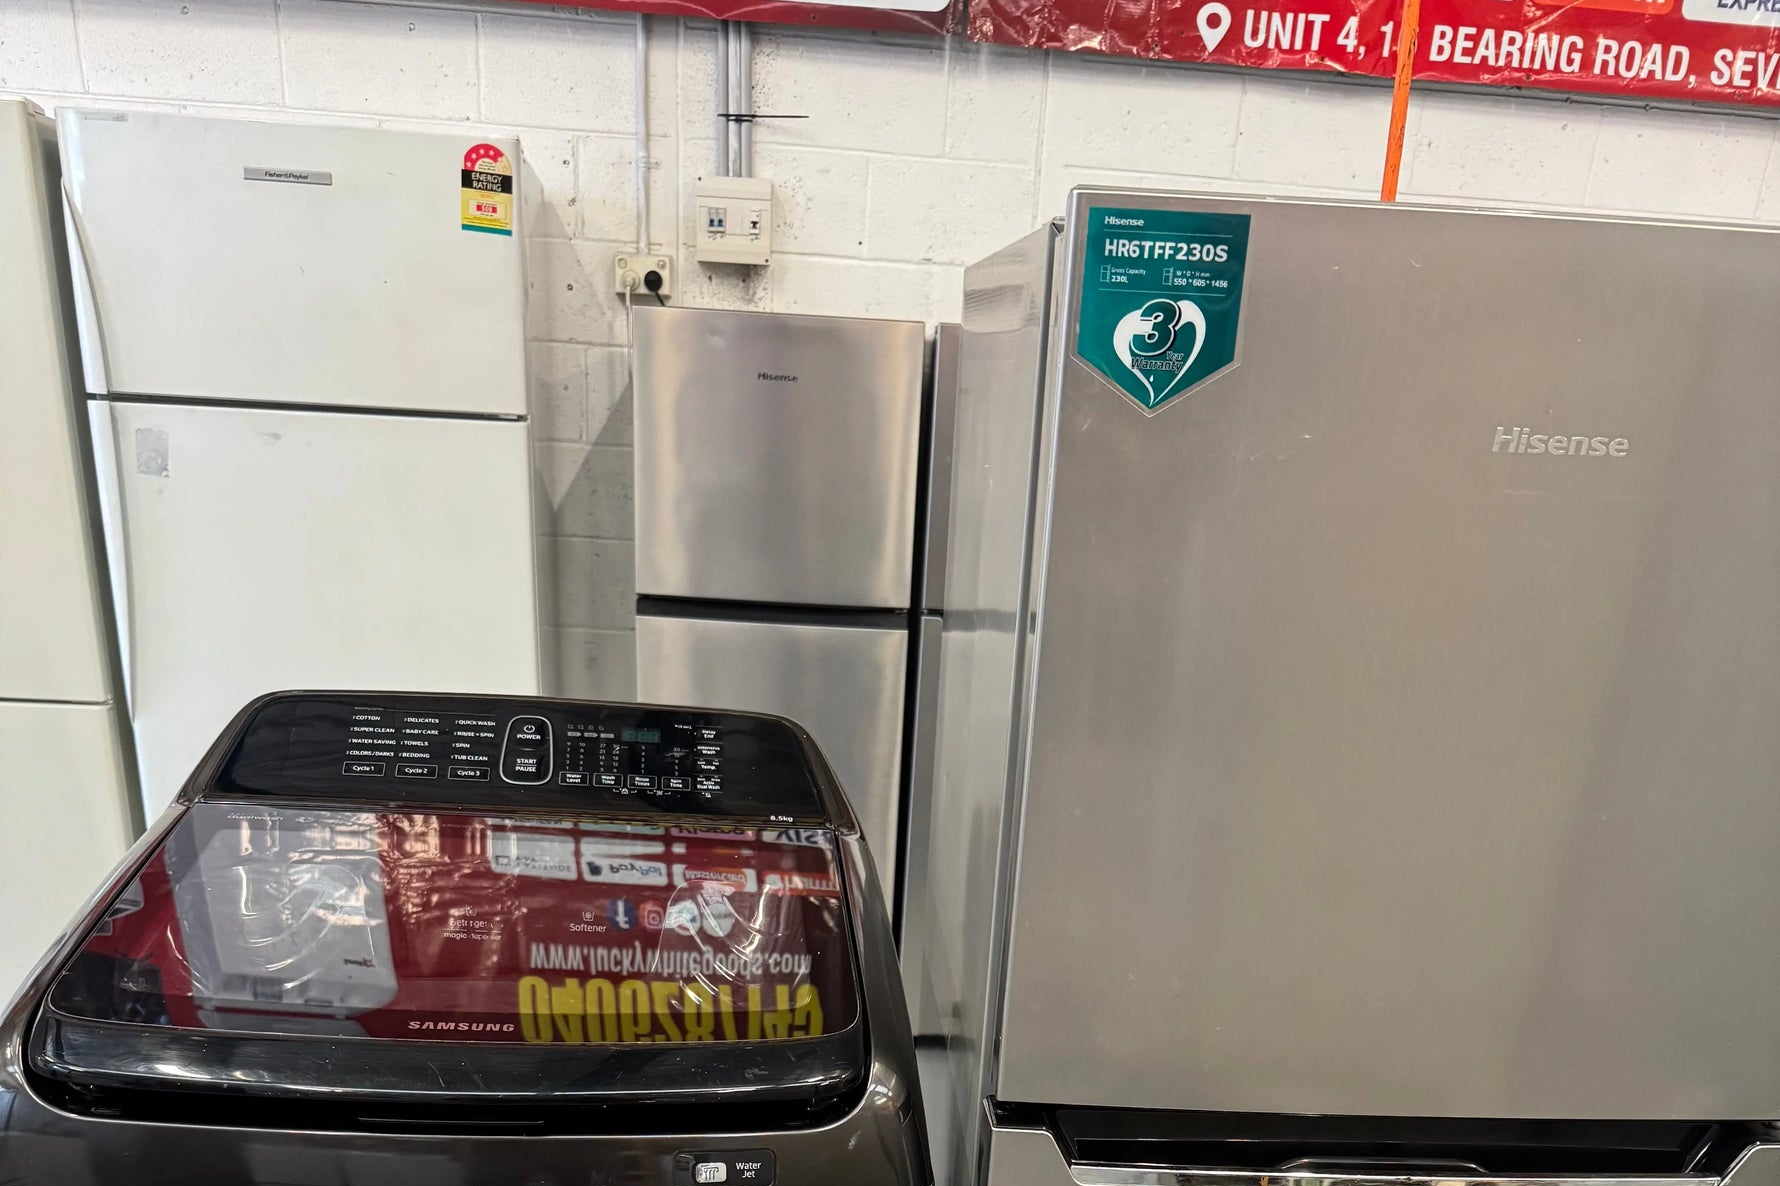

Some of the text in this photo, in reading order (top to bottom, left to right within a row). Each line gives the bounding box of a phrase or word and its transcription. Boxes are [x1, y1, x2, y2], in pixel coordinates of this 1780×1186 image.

[1243, 9, 1330, 51] UNIT
[1336, 16, 1366, 59] 4,
[1428, 24, 1584, 73] BEARING
[1593, 38, 1697, 89] ROAD,
[1710, 48, 1780, 90] SEV
[471, 172, 503, 184] ENERGY
[472, 181, 502, 192] RATING
[1104, 216, 1144, 227] Hisense
[1104, 238, 1228, 263] HR6TFF230S
[1111, 275, 1128, 283] 230L
[1174, 278, 1228, 288] 550 605 1456
[1130, 298, 1182, 356] 3
[1166, 350, 1184, 361] Year
[1131, 356, 1183, 374] Warranty
[757, 371, 799, 383] Hisense
[1491, 426, 1630, 457] Hisense
[404, 767, 422, 775] Cycle
[457, 769, 475, 777] Cycle
[770, 815, 794, 823] 8.5kg
[570, 923, 607, 933] Softener
[408, 1021, 515, 1032] SAMSUNG
[735, 1161, 762, 1170] Water
[742, 1169, 756, 1179] Jet
